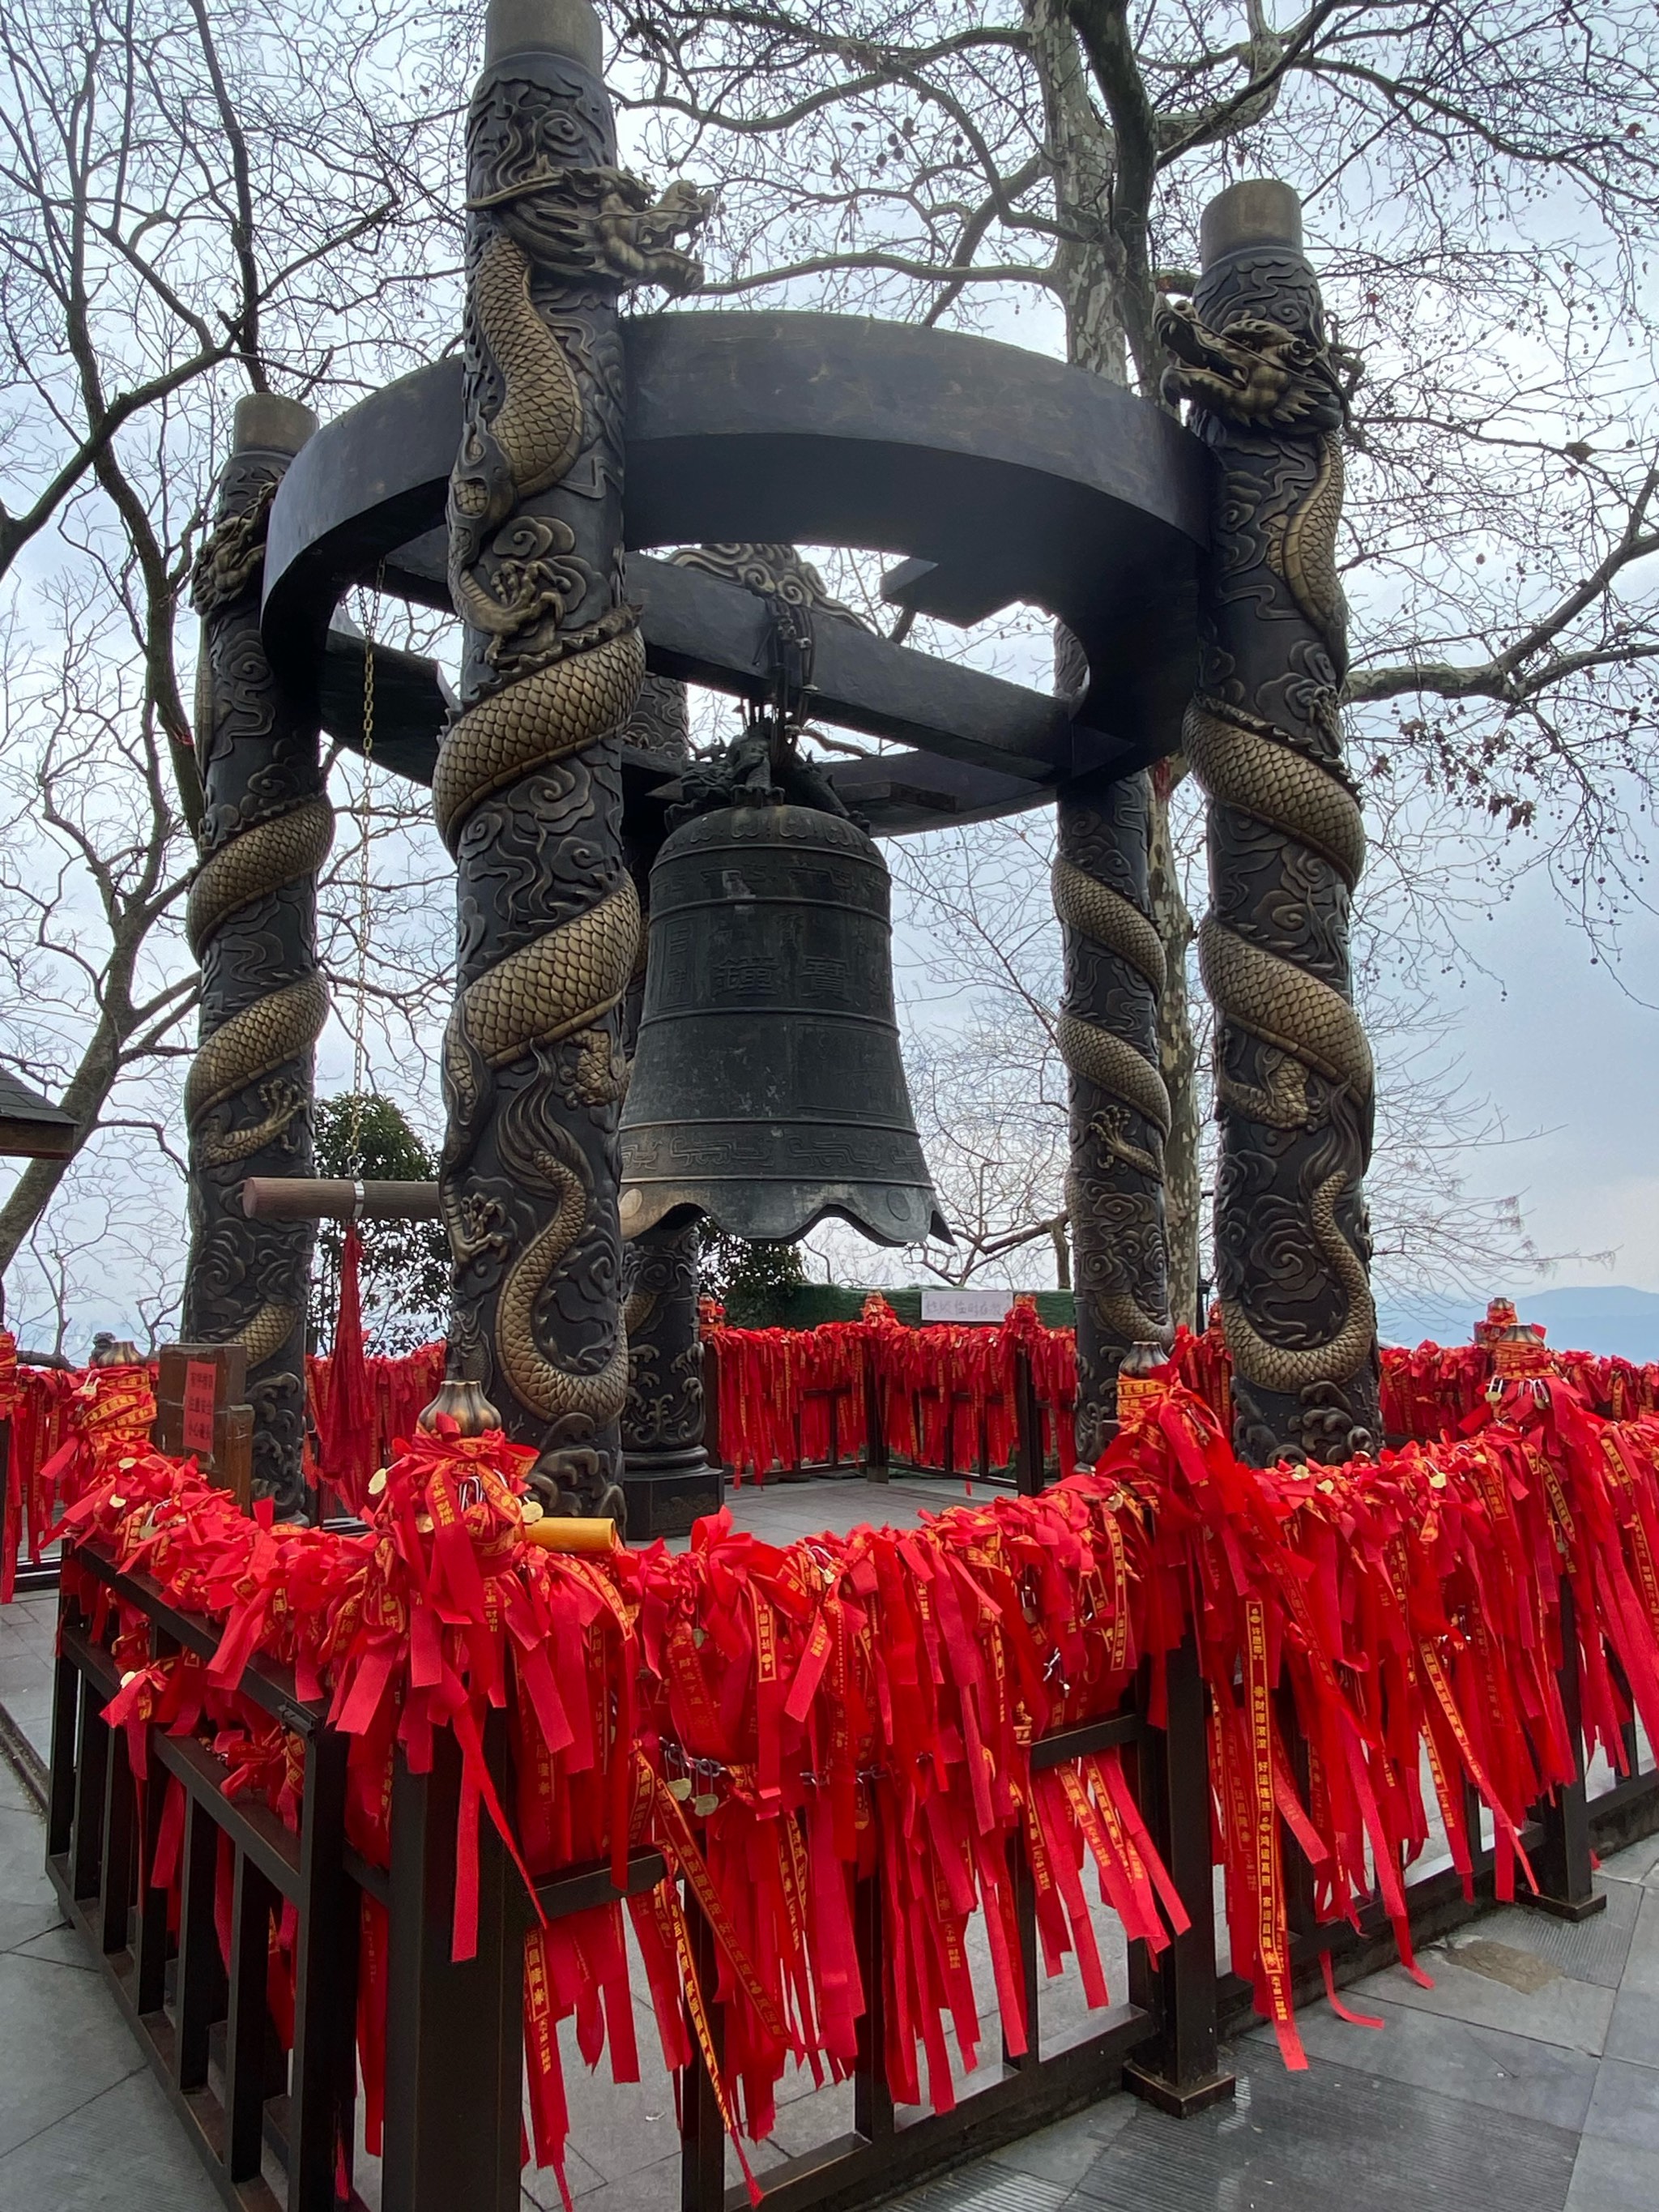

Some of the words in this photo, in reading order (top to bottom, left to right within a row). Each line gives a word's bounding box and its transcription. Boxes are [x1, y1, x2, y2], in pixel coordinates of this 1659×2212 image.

[1252, 1626, 1264, 1655] 许愿带
[1254, 1700, 1267, 1749] 财源滚滚
[1257, 1761, 1271, 1812] 好运连连
[1260, 1834, 1271, 1887] 鸿运高照
[1261, 1896, 1273, 1949] 家运昌隆
